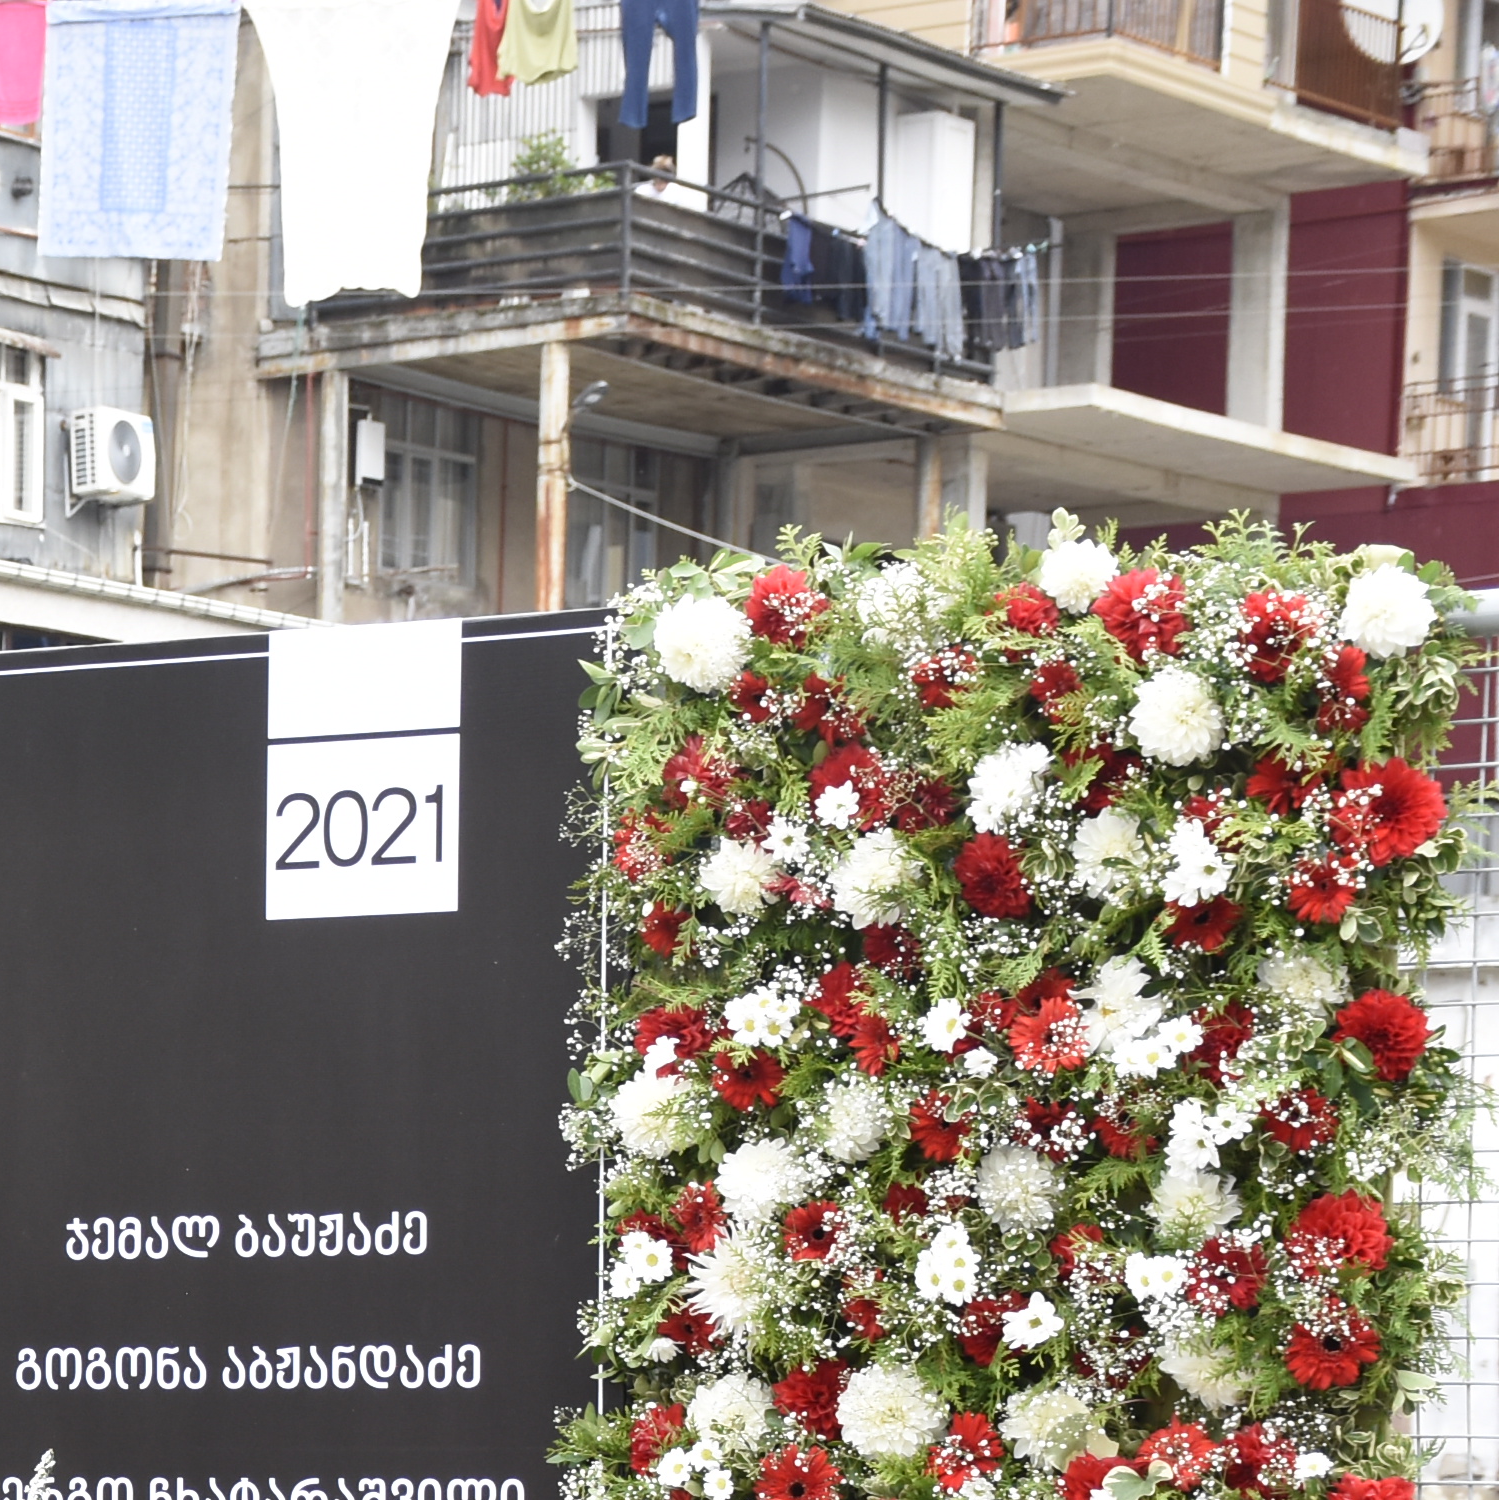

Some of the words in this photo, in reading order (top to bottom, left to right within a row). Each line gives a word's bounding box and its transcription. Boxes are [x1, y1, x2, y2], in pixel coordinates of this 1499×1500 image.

[275, 784, 443, 871] 2021
[65, 1215, 220, 1261] ჯემალ
[234, 1210, 428, 1258] ბაუჟაძე
[15, 1346, 207, 1391] გოგონა
[222, 1343, 481, 1390] აბჟანდაძე
